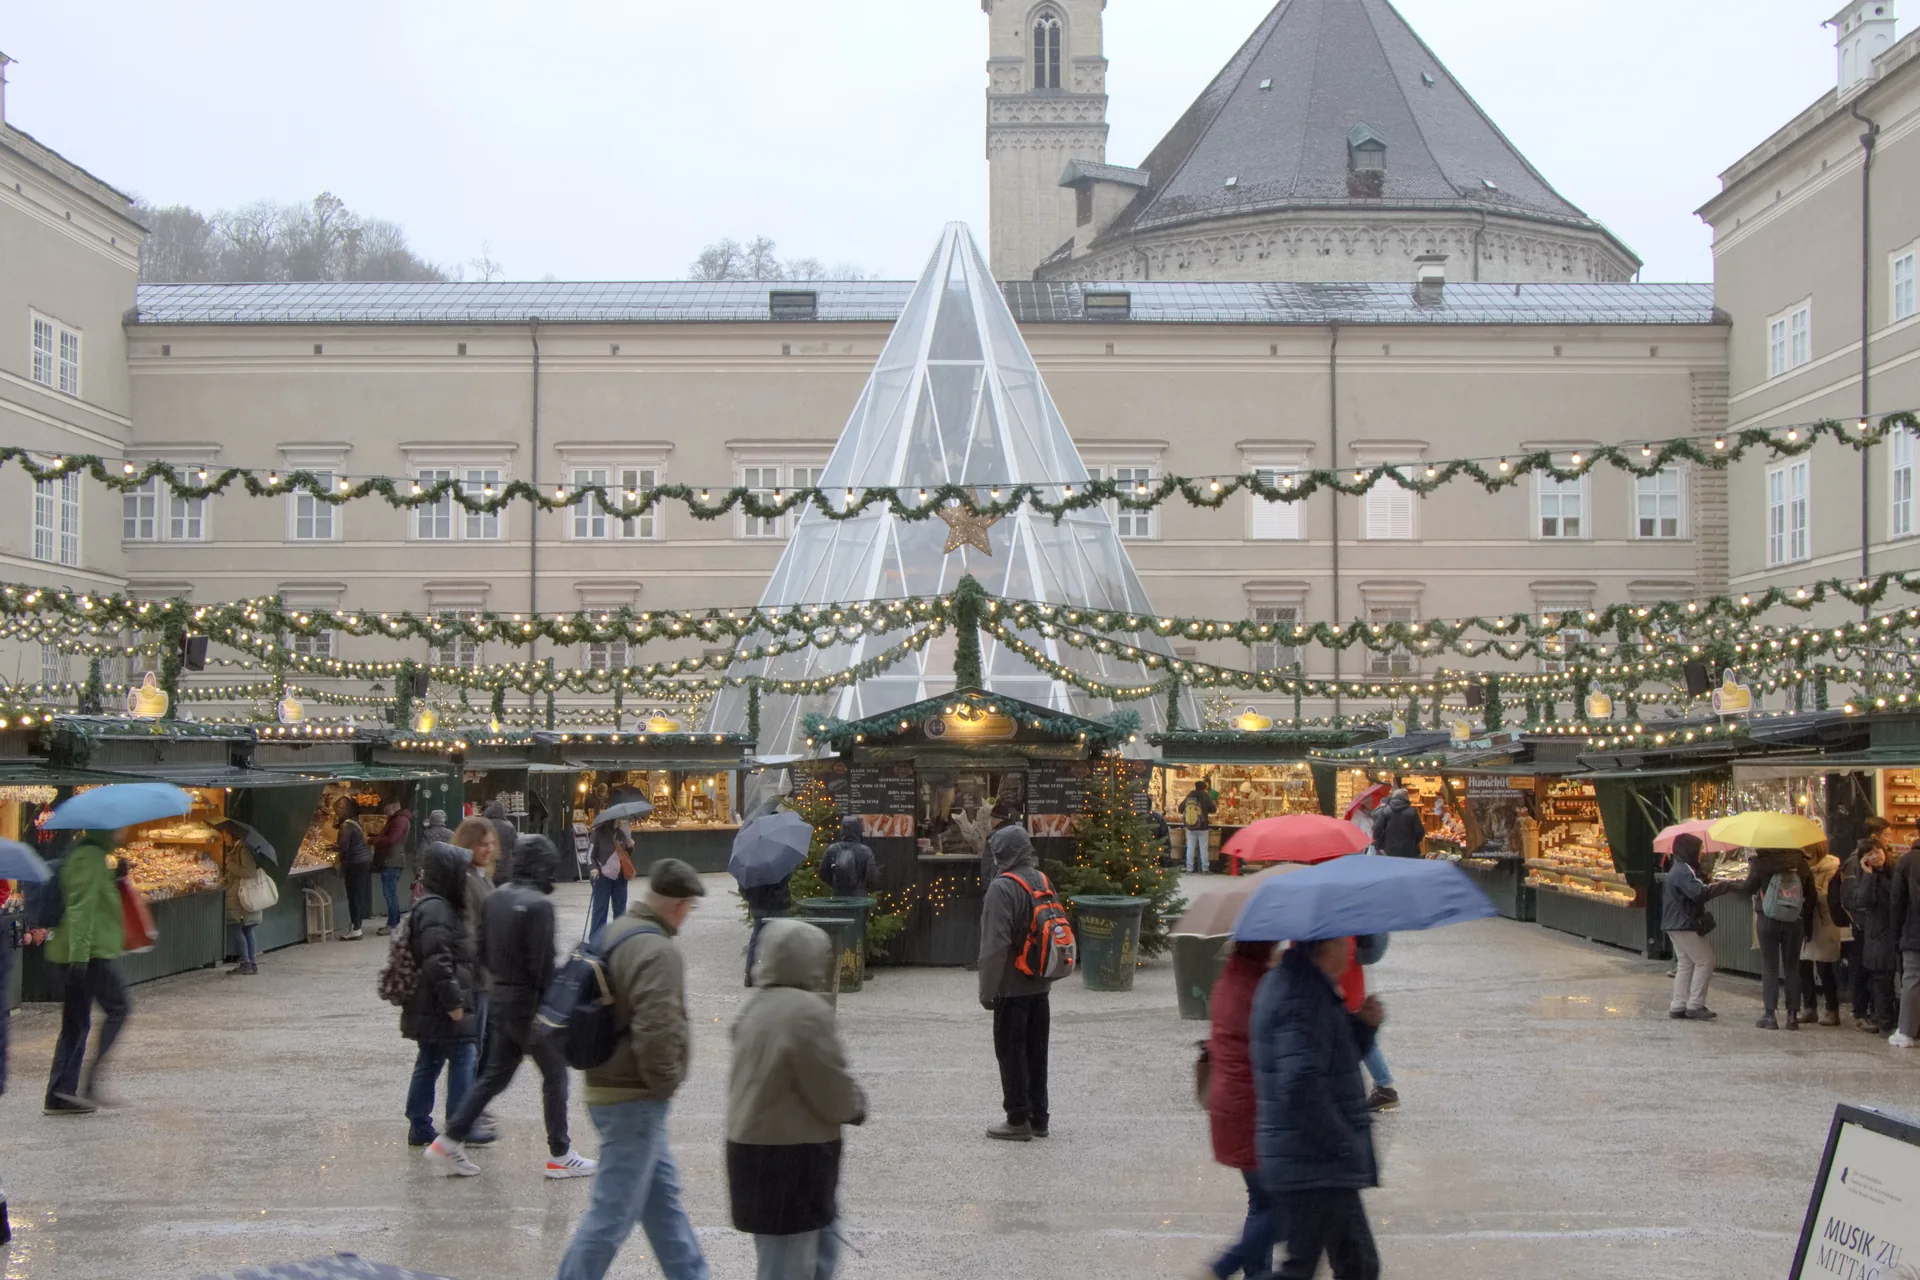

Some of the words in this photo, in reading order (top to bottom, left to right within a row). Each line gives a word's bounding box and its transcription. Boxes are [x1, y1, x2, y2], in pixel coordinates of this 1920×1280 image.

[929, 722, 944, 732] 44
[1824, 1217, 1875, 1257] MUSIK
[1876, 1240, 1903, 1269] ZU
